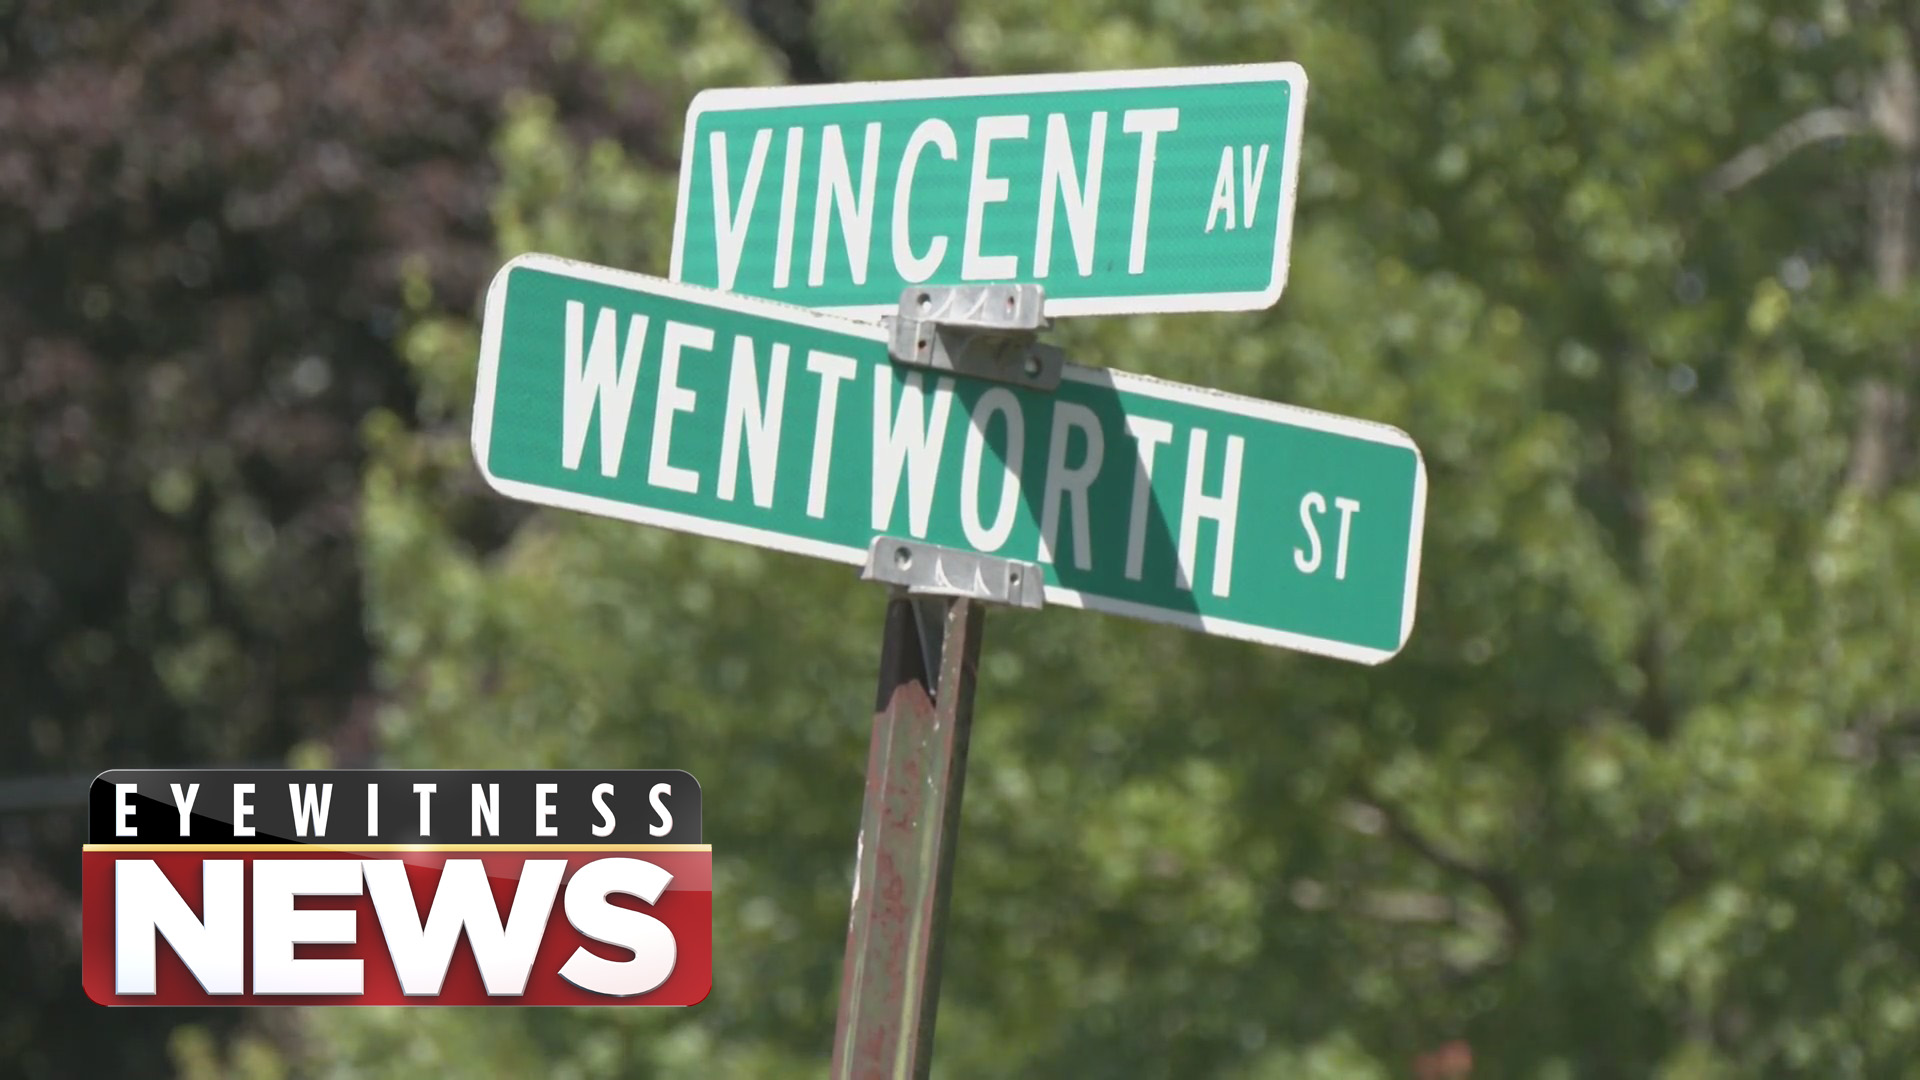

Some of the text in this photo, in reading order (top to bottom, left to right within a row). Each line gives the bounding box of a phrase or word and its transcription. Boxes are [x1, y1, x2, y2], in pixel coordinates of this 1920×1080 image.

[709, 107, 1269, 291] VINCENT AV
[562, 299, 1360, 598] WENTWORTH ST
